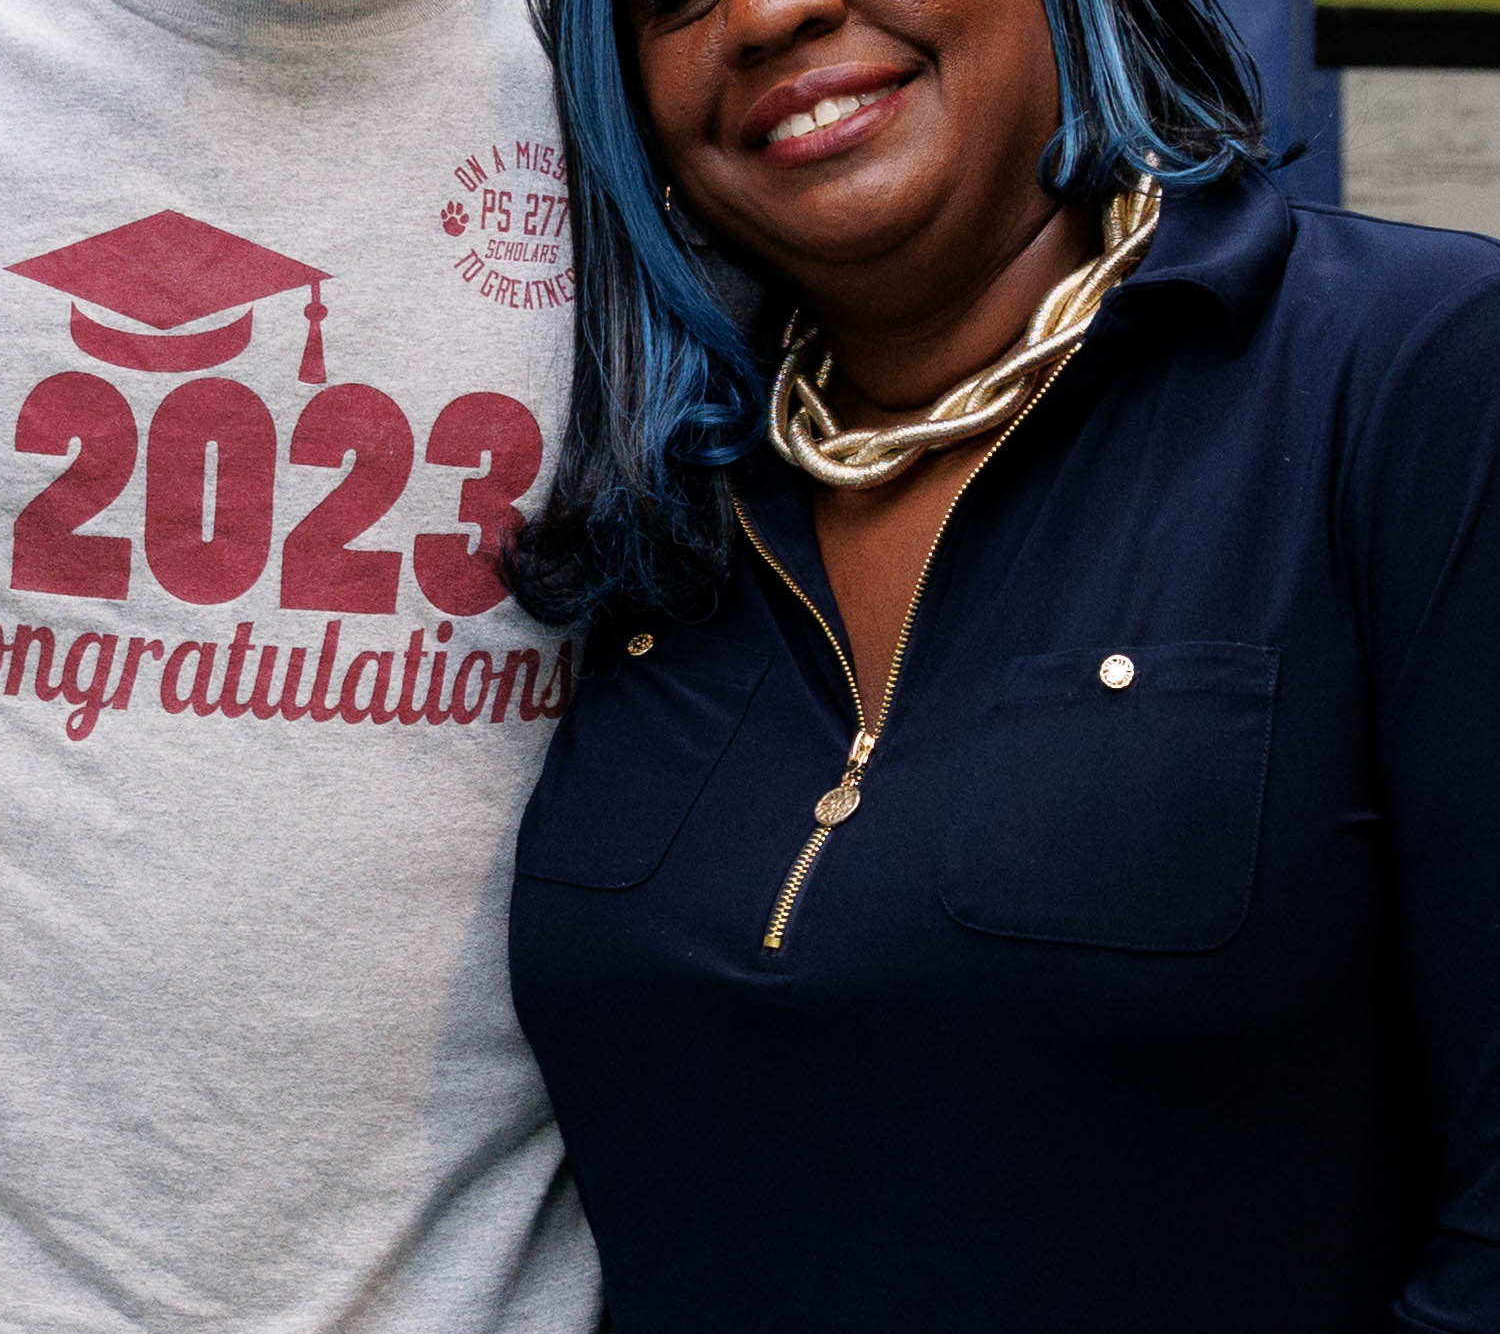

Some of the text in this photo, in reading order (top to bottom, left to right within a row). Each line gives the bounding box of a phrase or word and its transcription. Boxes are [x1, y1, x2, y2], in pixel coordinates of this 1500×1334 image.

[454, 140, 568, 192] ON A MISS
[481, 188, 569, 237] PS 277
[454, 248, 485, 283] TO
[485, 239, 559, 264] SCHOLARS
[10, 370, 544, 617] 2023
